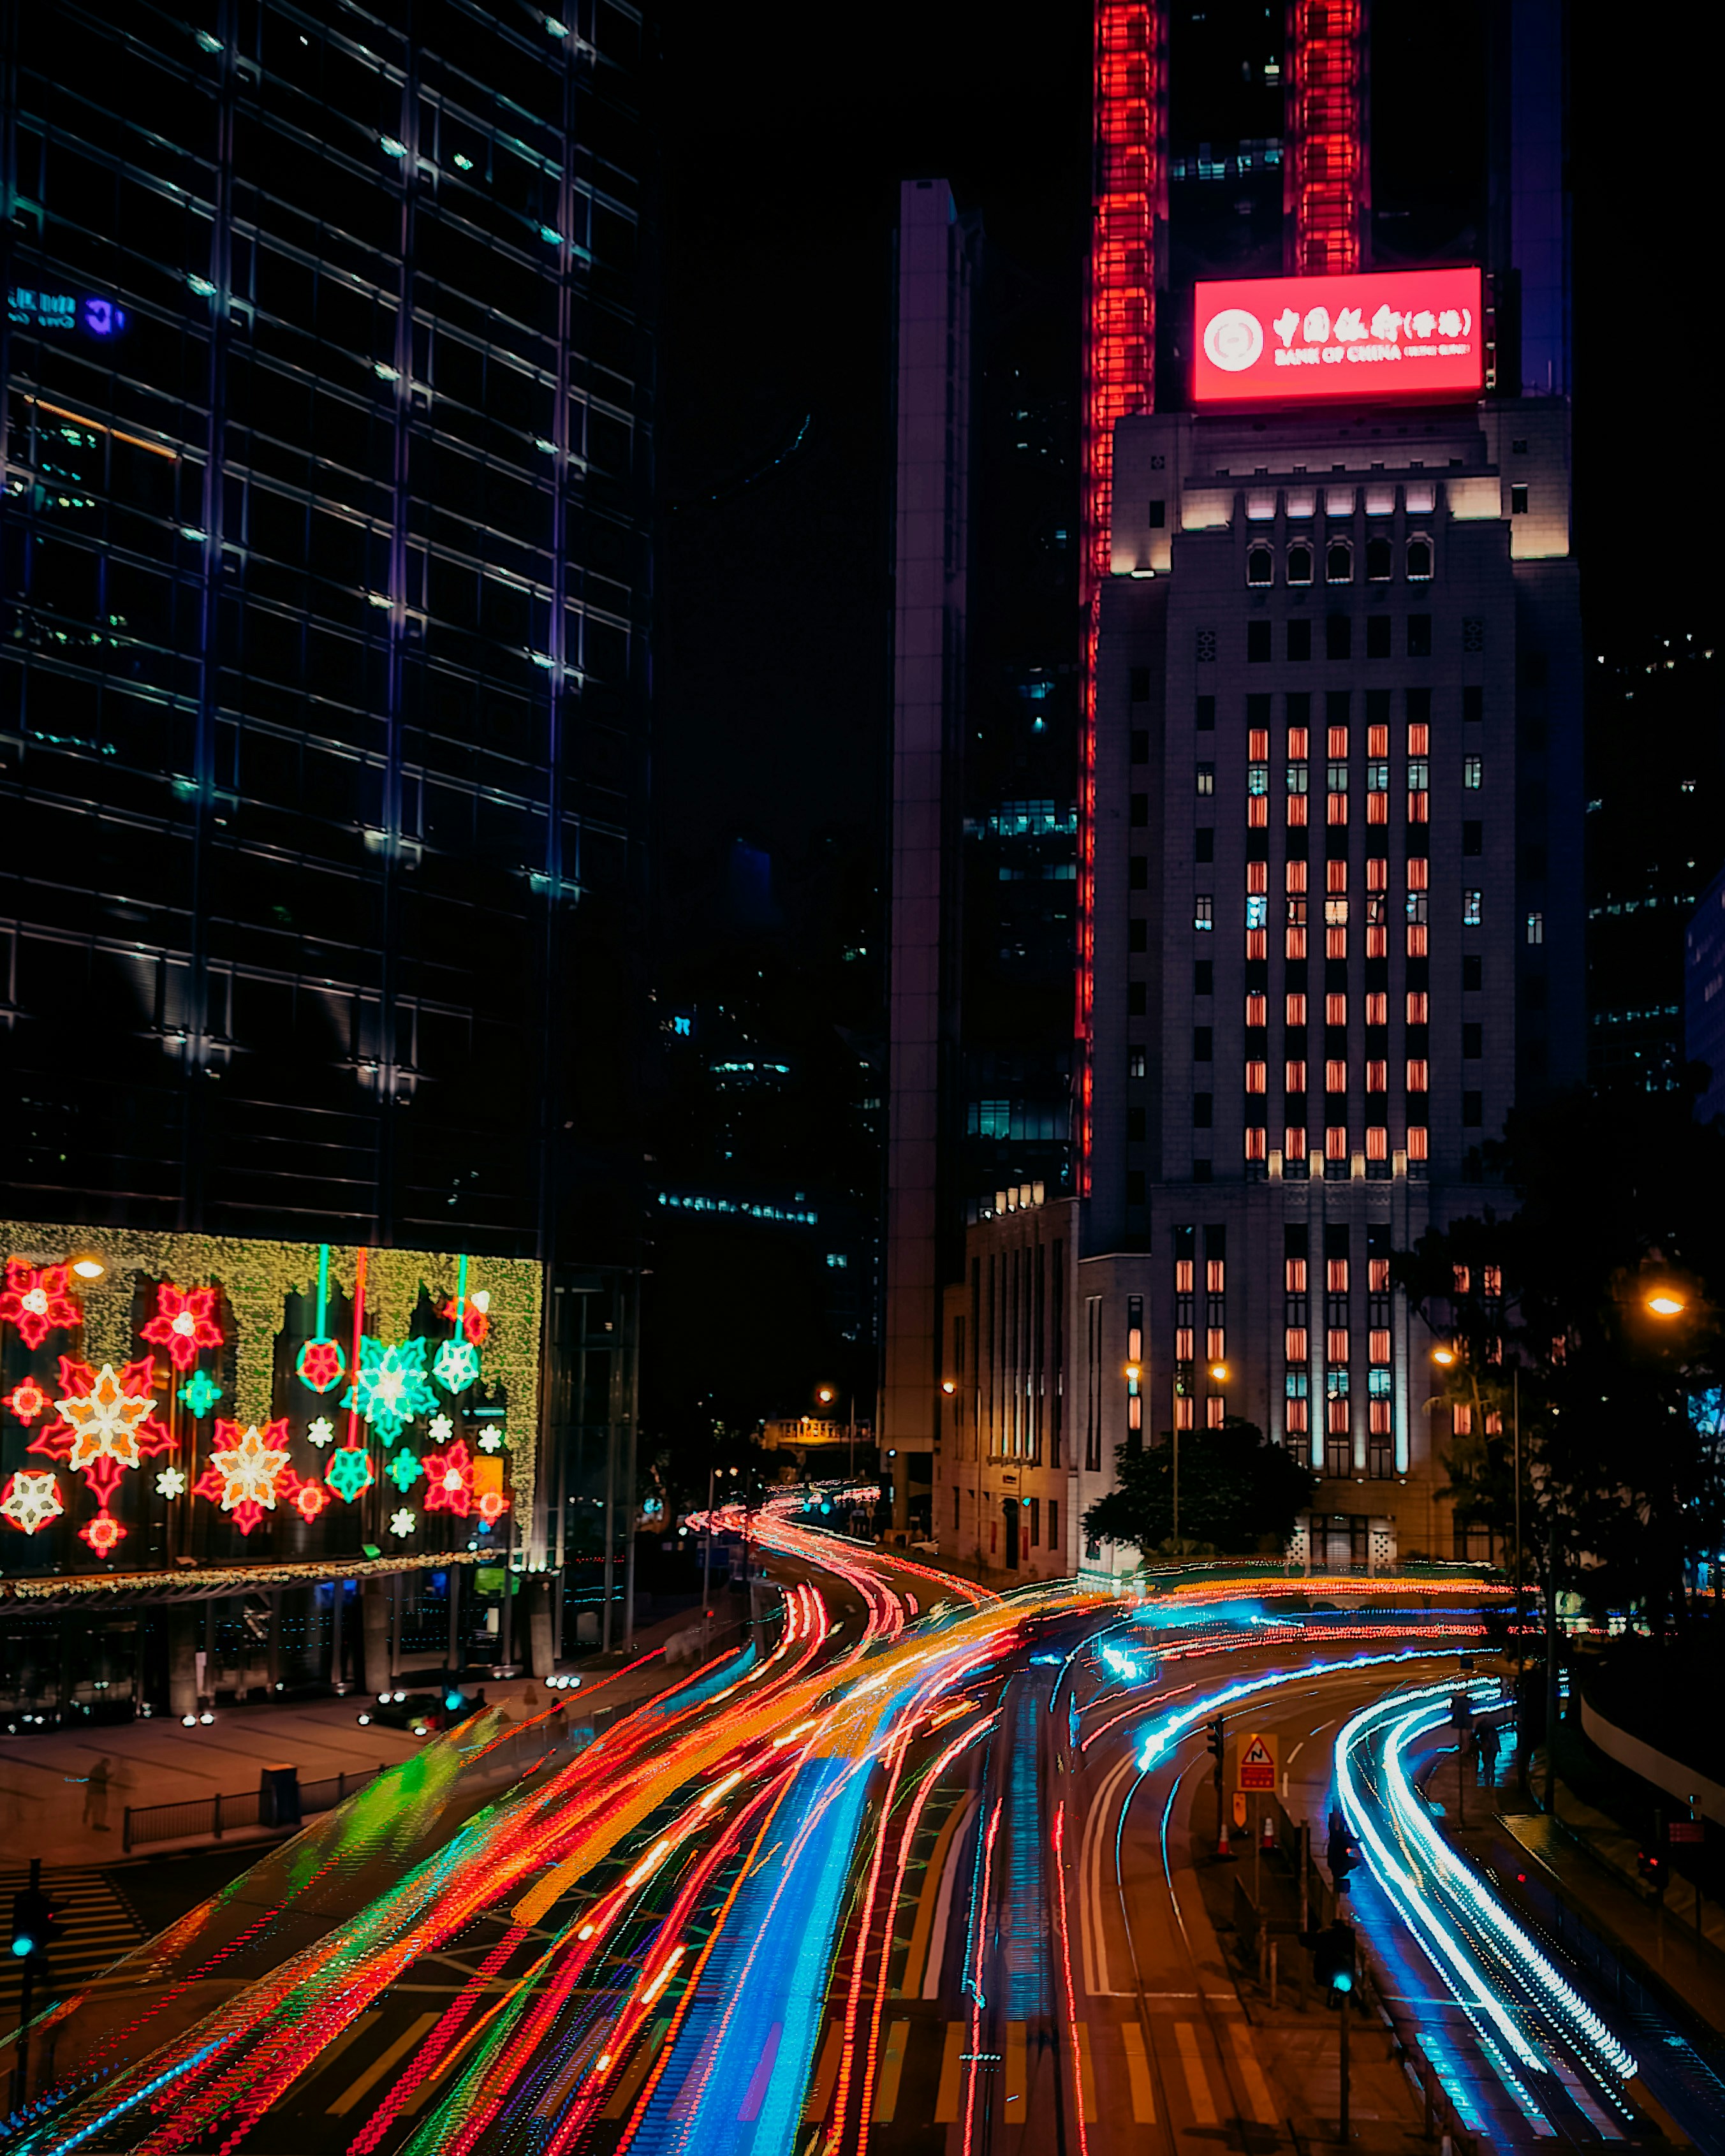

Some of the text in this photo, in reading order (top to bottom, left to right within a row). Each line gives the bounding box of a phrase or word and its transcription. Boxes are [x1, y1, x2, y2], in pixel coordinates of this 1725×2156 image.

[1275, 347, 1320, 366] BANK
[1322, 346, 1344, 363] OF
[1347, 344, 1402, 362] CHINA
